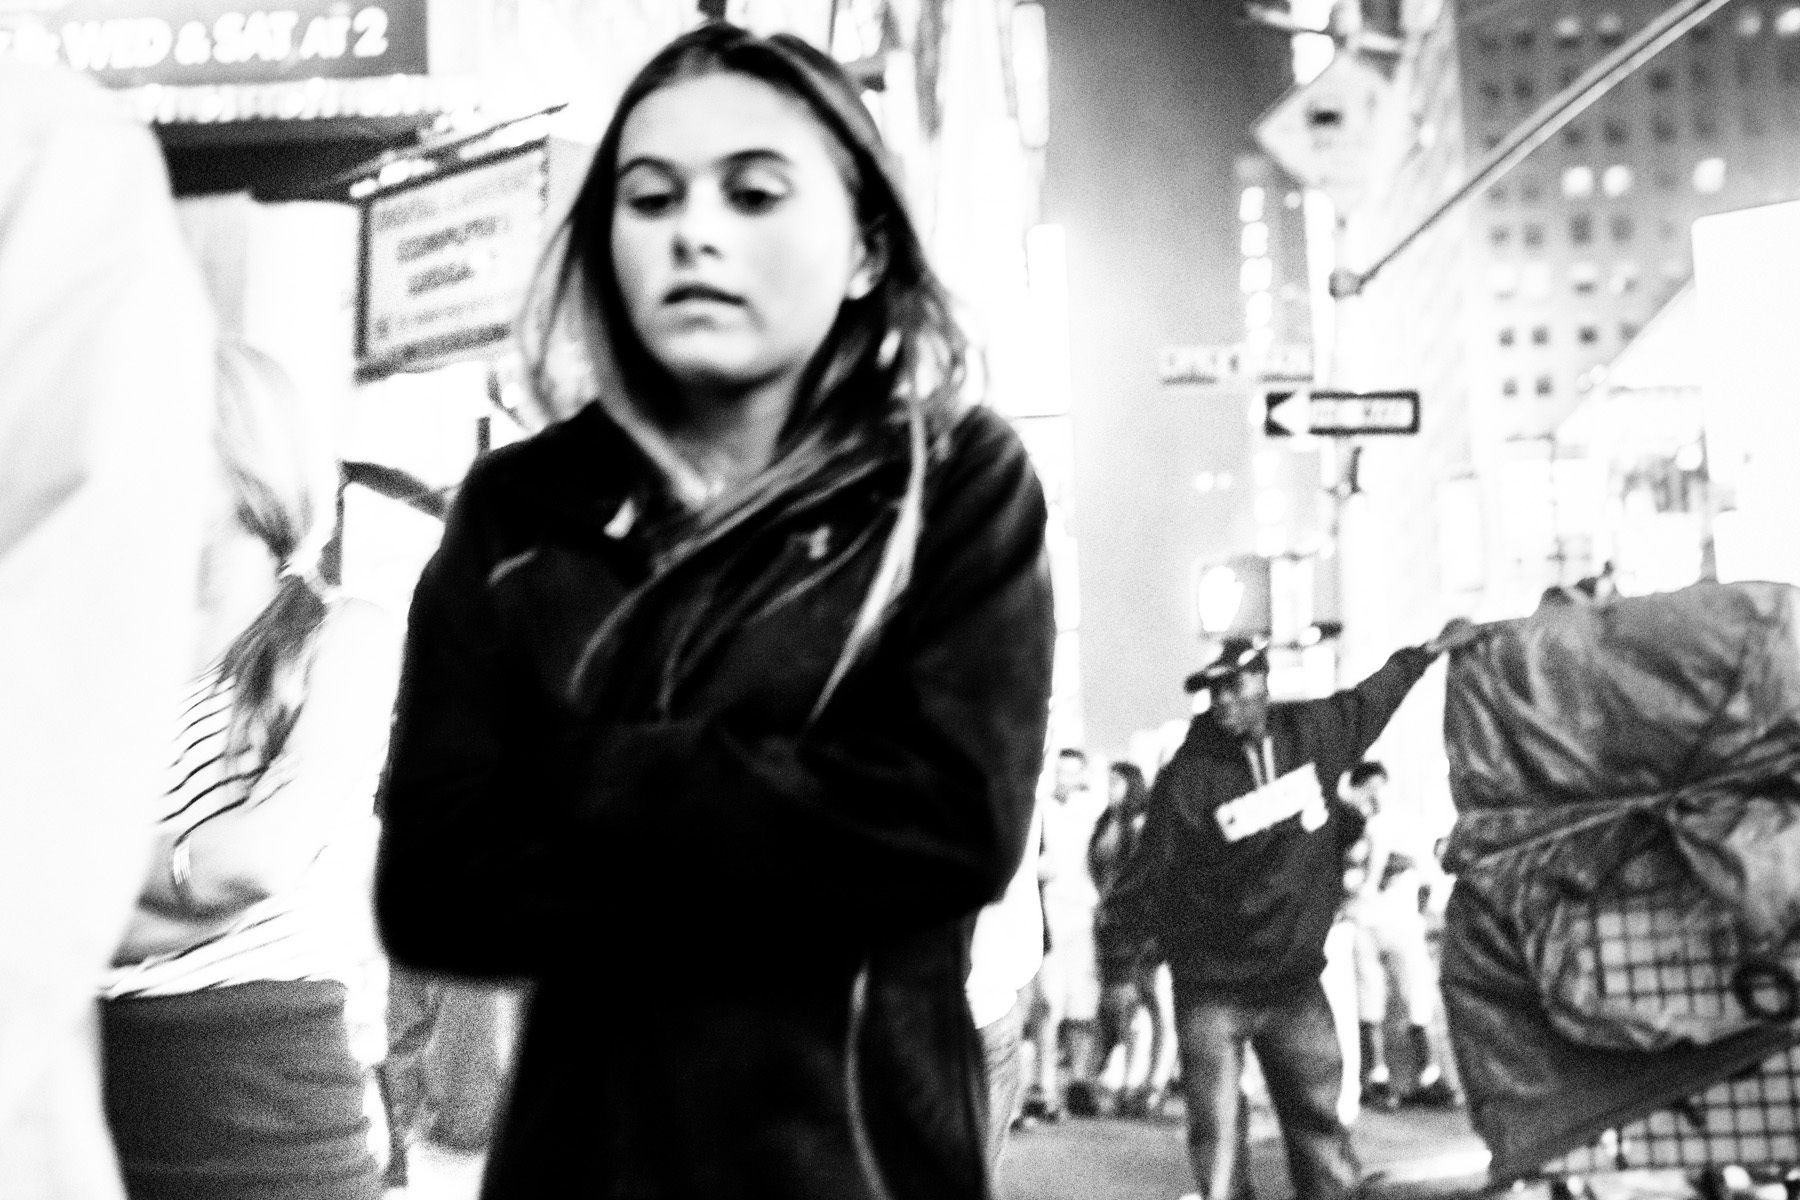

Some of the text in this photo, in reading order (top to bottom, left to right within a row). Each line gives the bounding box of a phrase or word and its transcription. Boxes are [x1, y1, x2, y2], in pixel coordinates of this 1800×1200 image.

[62, 18, 173, 71] WED
[175, 20, 212, 65] &
[212, 10, 299, 64] SAT
[353, 7, 389, 57] 2
